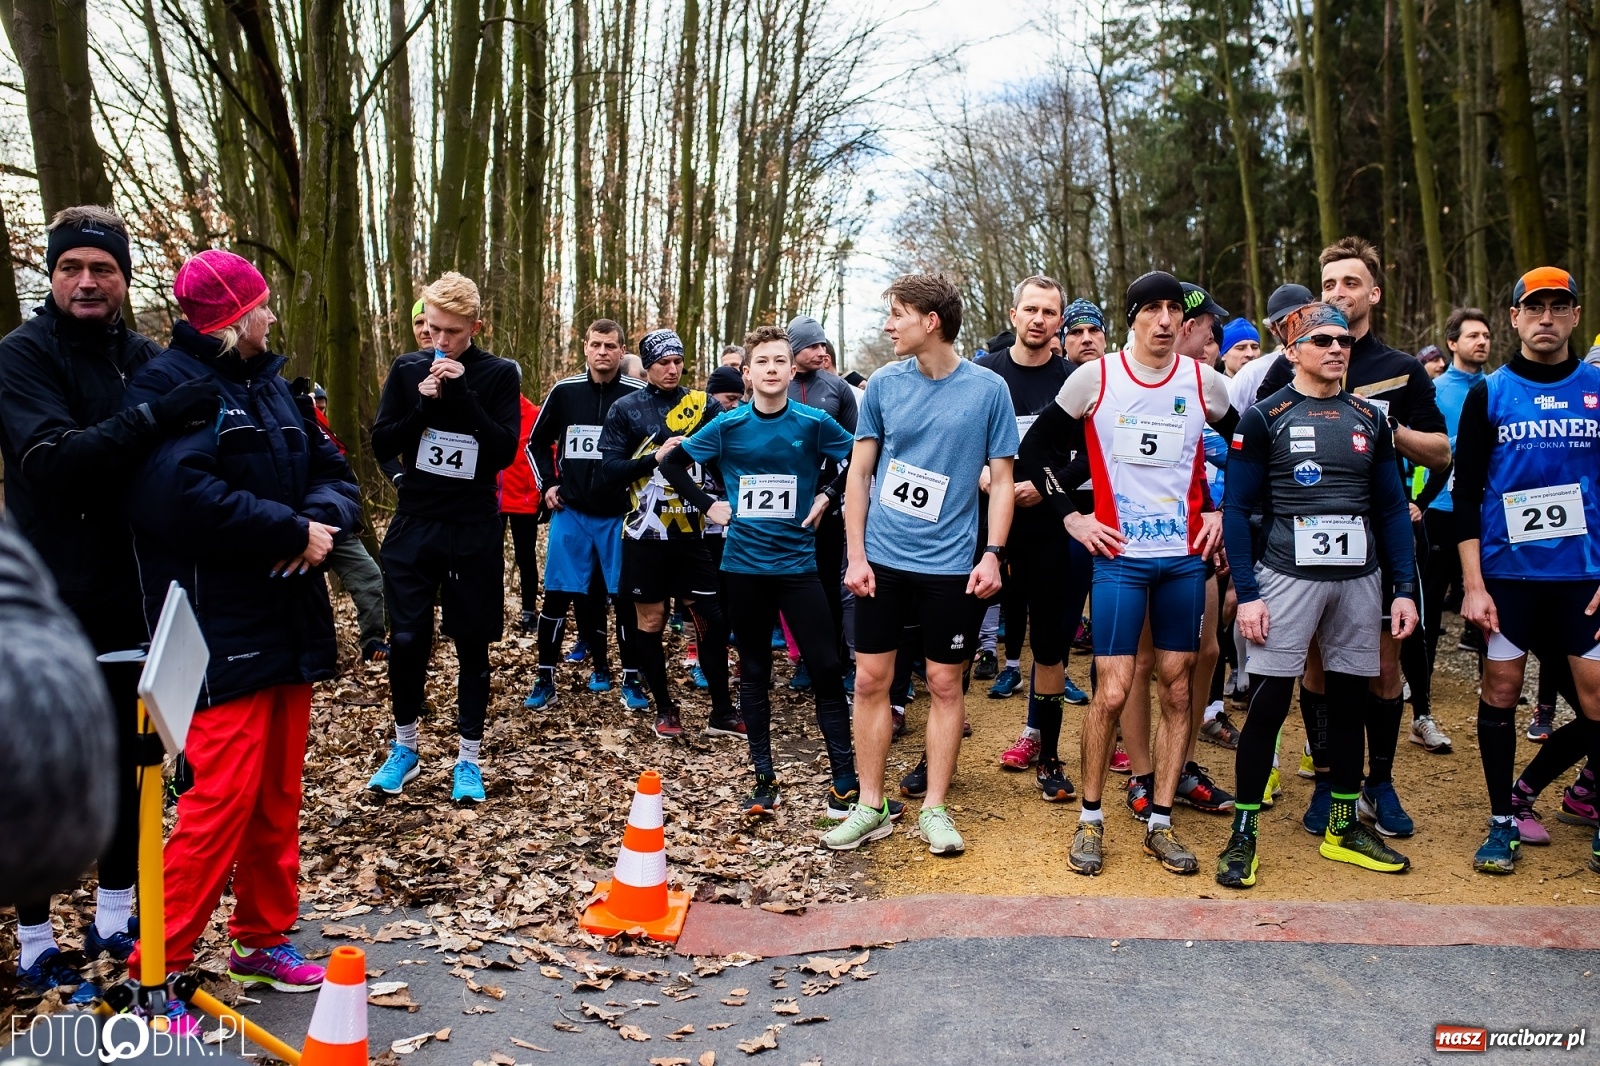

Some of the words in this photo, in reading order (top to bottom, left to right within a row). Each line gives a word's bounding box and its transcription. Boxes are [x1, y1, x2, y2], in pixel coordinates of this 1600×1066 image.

[1498, 419, 1600, 443] RUNNER
[569, 437, 601, 453] 16
[792, 440, 804, 448] 4F
[1139, 433, 1158, 456] 5
[428, 446, 463, 470] 34
[743, 490, 790, 510] 121
[893, 481, 929, 509] 49
[1522, 505, 1567, 532] 29
[1312, 532, 1349, 556] 31
